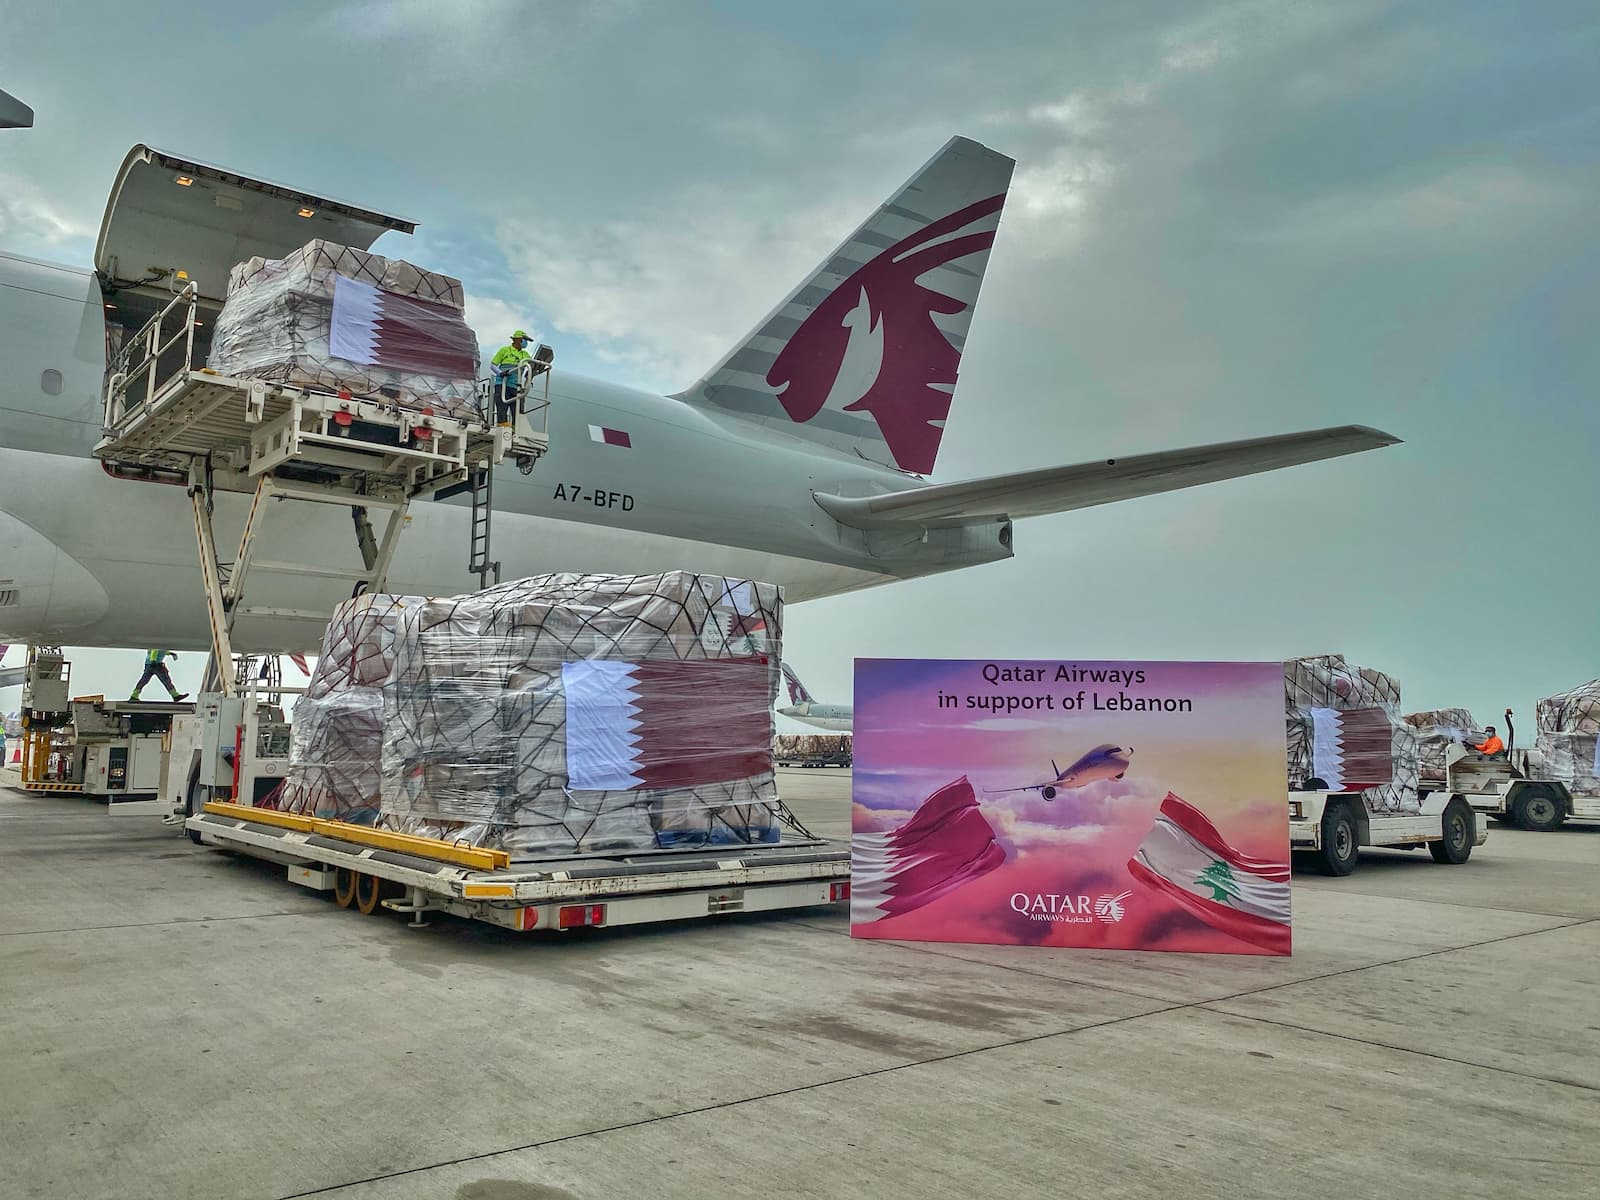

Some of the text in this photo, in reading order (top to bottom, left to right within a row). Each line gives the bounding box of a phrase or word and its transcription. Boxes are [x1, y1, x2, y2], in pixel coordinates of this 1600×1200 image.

[553, 483, 635, 512] A7-BFD
[982, 663, 1146, 688] Qatar Airways
[938, 690, 1192, 714] in support of Lebanon
[1010, 893, 1092, 916] QATAR
[1030, 914, 1064, 922] AIRWAYS
